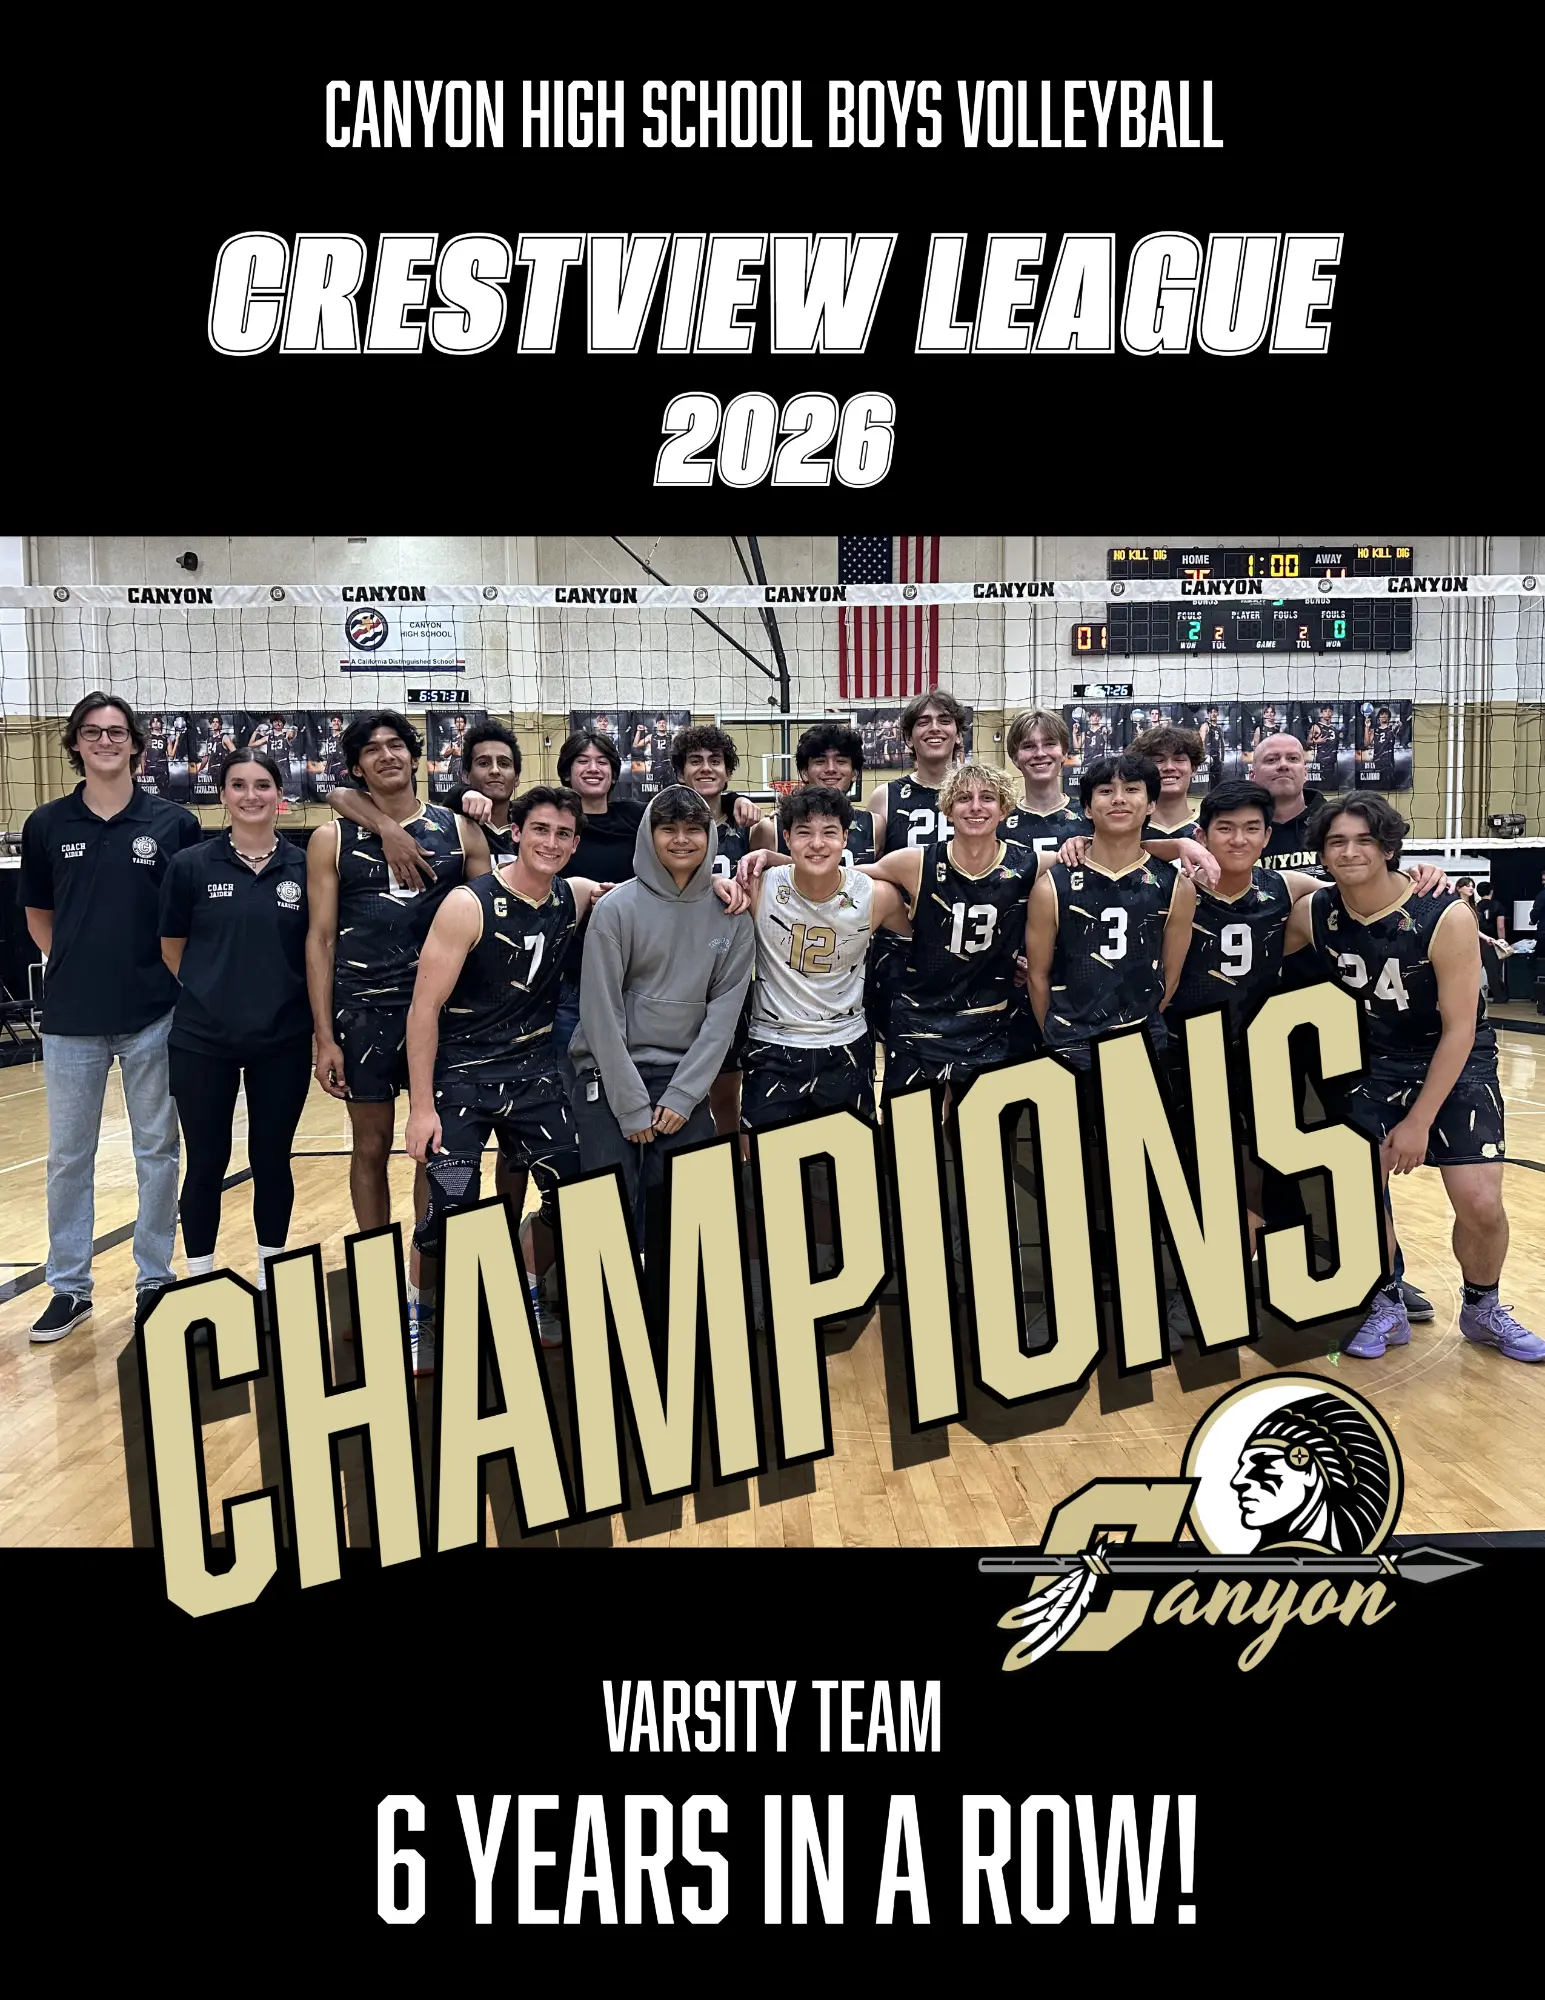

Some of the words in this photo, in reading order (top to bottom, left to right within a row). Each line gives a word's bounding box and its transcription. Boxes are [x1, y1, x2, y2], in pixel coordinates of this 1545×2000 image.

[1129, 549, 1149, 560] KILL
[1153, 549, 1167, 560] DIG
[1315, 554, 1342, 564] AWAY
[1372, 548, 1392, 558] KILL
[1396, 547, 1410, 558] DIG
[1182, 554, 1209, 565] HOME
[1248, 554, 1299, 577] 1:00
[973, 582, 1055, 598] CANYON
[1181, 579, 1263, 596] CANYON
[1387, 577, 1468, 593] CANYON
[128, 587, 213, 604] CANYON
[342, 586, 426, 602] CANYON
[555, 587, 638, 604] CANYON
[764, 586, 847, 603] CANYON
[1177, 611, 1202, 620] FOULS
[1231, 610, 1261, 620] PLAYER
[1273, 610, 1298, 619] FOULS
[1321, 610, 1346, 619] FOULS
[1188, 621, 1201, 640] 2
[1214, 626, 1224, 640] 2
[1299, 626, 1308, 639] 2
[1334, 619, 1346, 639] 0
[1212, 641, 1226, 649] TOL
[1256, 640, 1277, 649] GAME
[1296, 640, 1311, 648] TOL
[388, 658, 431, 666] Distinguished
[420, 690, 465, 702] 6:57:31
[61, 842, 86, 852] COACH
[1252, 851, 1318, 870] ANYON
[207, 883, 234, 892] COACH
[277, 900, 300, 911] VARSITY
[950, 902, 998, 953] 13
[1100, 907, 1128, 960] 3
[789, 923, 836, 974] 12
[1220, 923, 1253, 977] 9
[524, 932, 545, 986] 7
